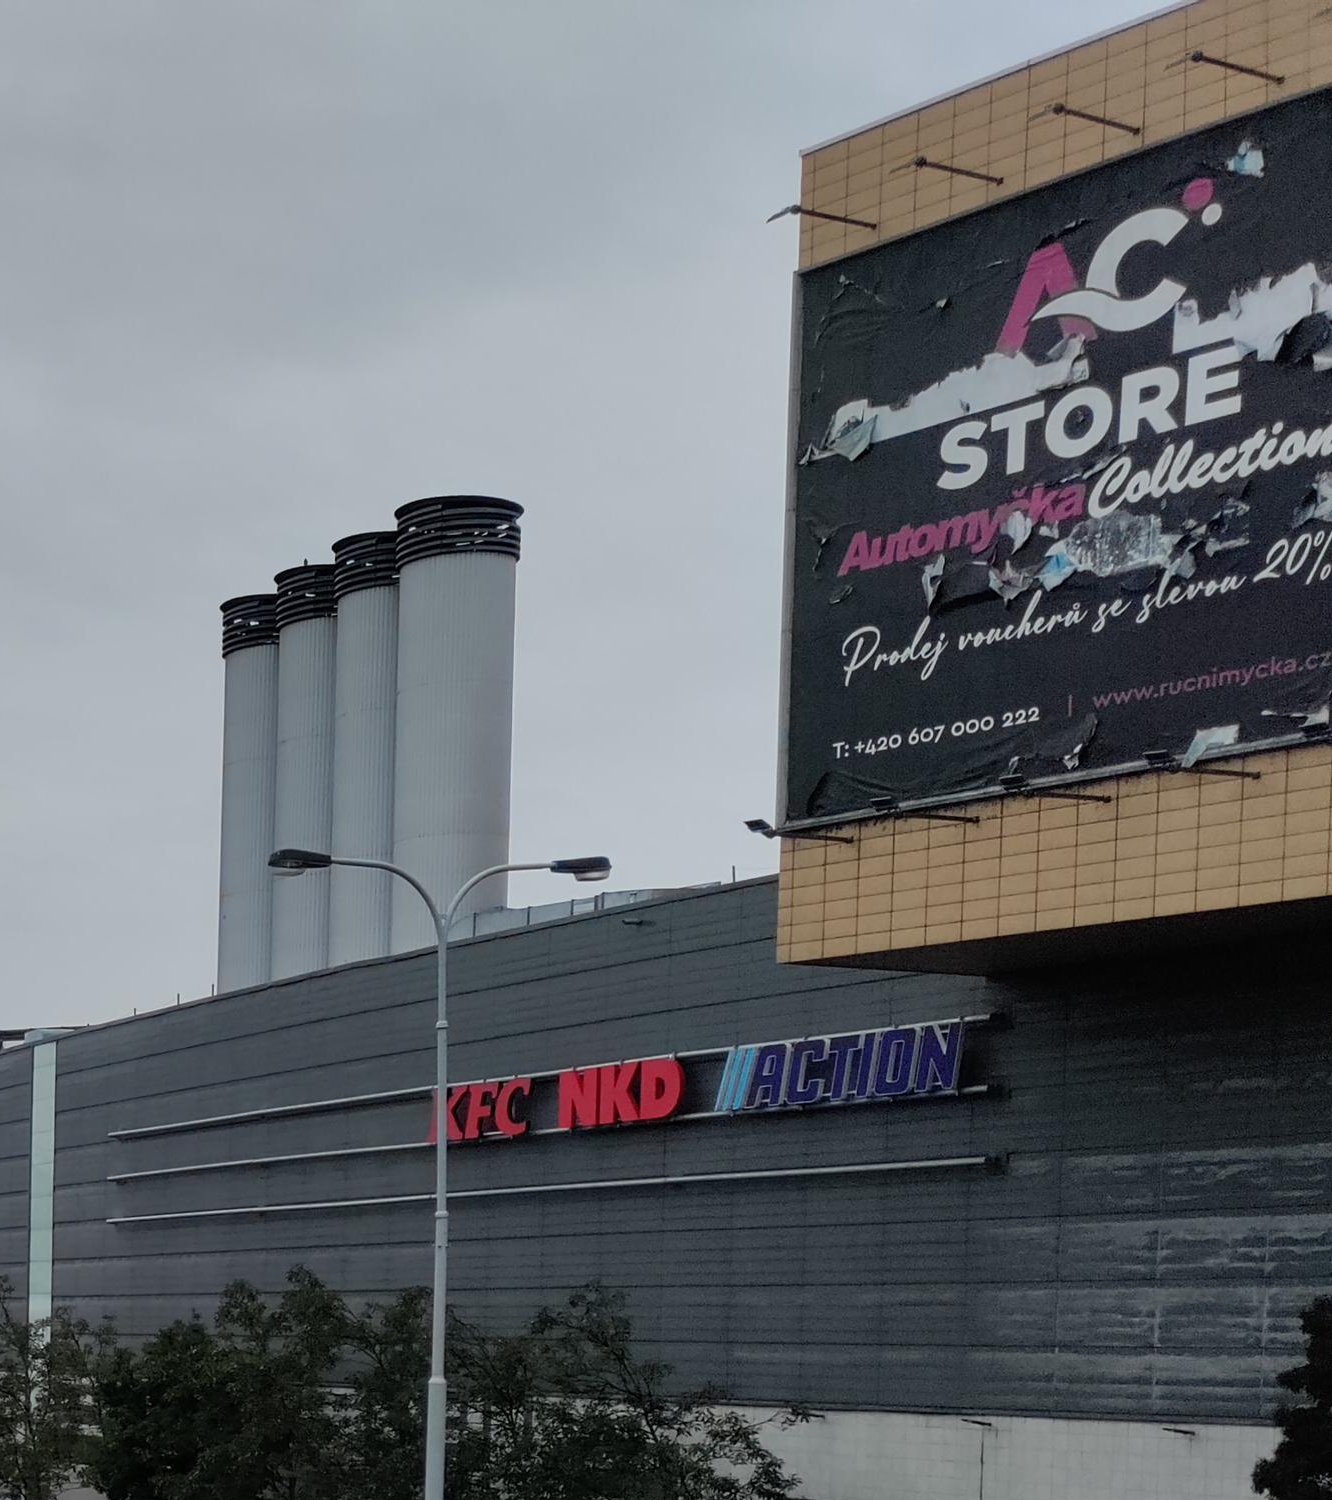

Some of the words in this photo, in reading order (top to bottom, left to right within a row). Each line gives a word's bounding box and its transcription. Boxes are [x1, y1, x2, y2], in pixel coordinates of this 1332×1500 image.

[936, 344, 1243, 490] STORE
[1088, 421, 1332, 518] Collection
[841, 615, 949, 687] Prodej
[958, 589, 1088, 651] voucherů
[1092, 599, 1133, 633] se
[1136, 557, 1247, 624] slevou
[1253, 530, 1332, 585] 20%
[833, 742, 850, 759] T:
[854, 734, 902, 755] +420
[908, 725, 945, 743] 607
[951, 716, 995, 736] 000
[1001, 707, 1040, 728] 222
[1093, 651, 1332, 709] www.rucnimycka.cz
[426, 1077, 533, 1144] KFC
[557, 1057, 687, 1130] NKD
[744, 1020, 964, 1110] ACTION
